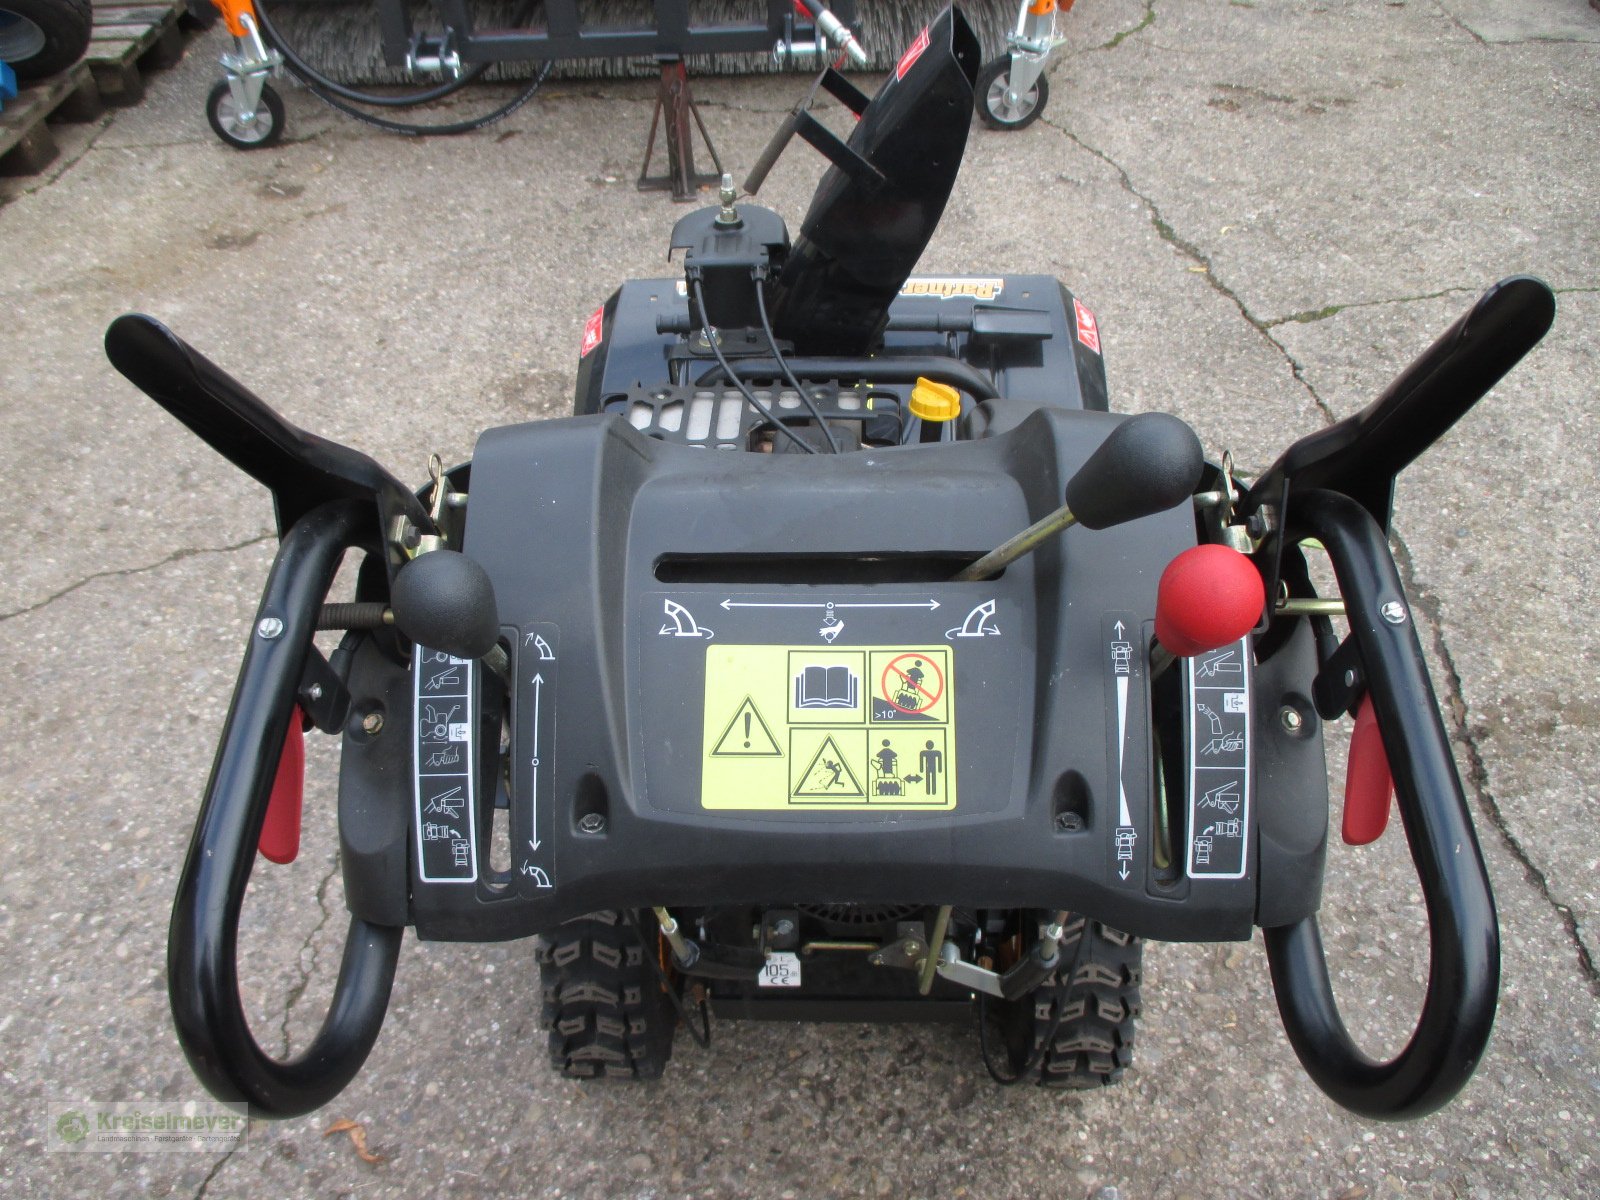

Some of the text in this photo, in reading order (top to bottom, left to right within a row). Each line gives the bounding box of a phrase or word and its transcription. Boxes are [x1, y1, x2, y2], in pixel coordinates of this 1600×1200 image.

[900, 281, 997, 299] Partner
[765, 963, 789, 977] 105
[770, 976, 789, 985] CE
